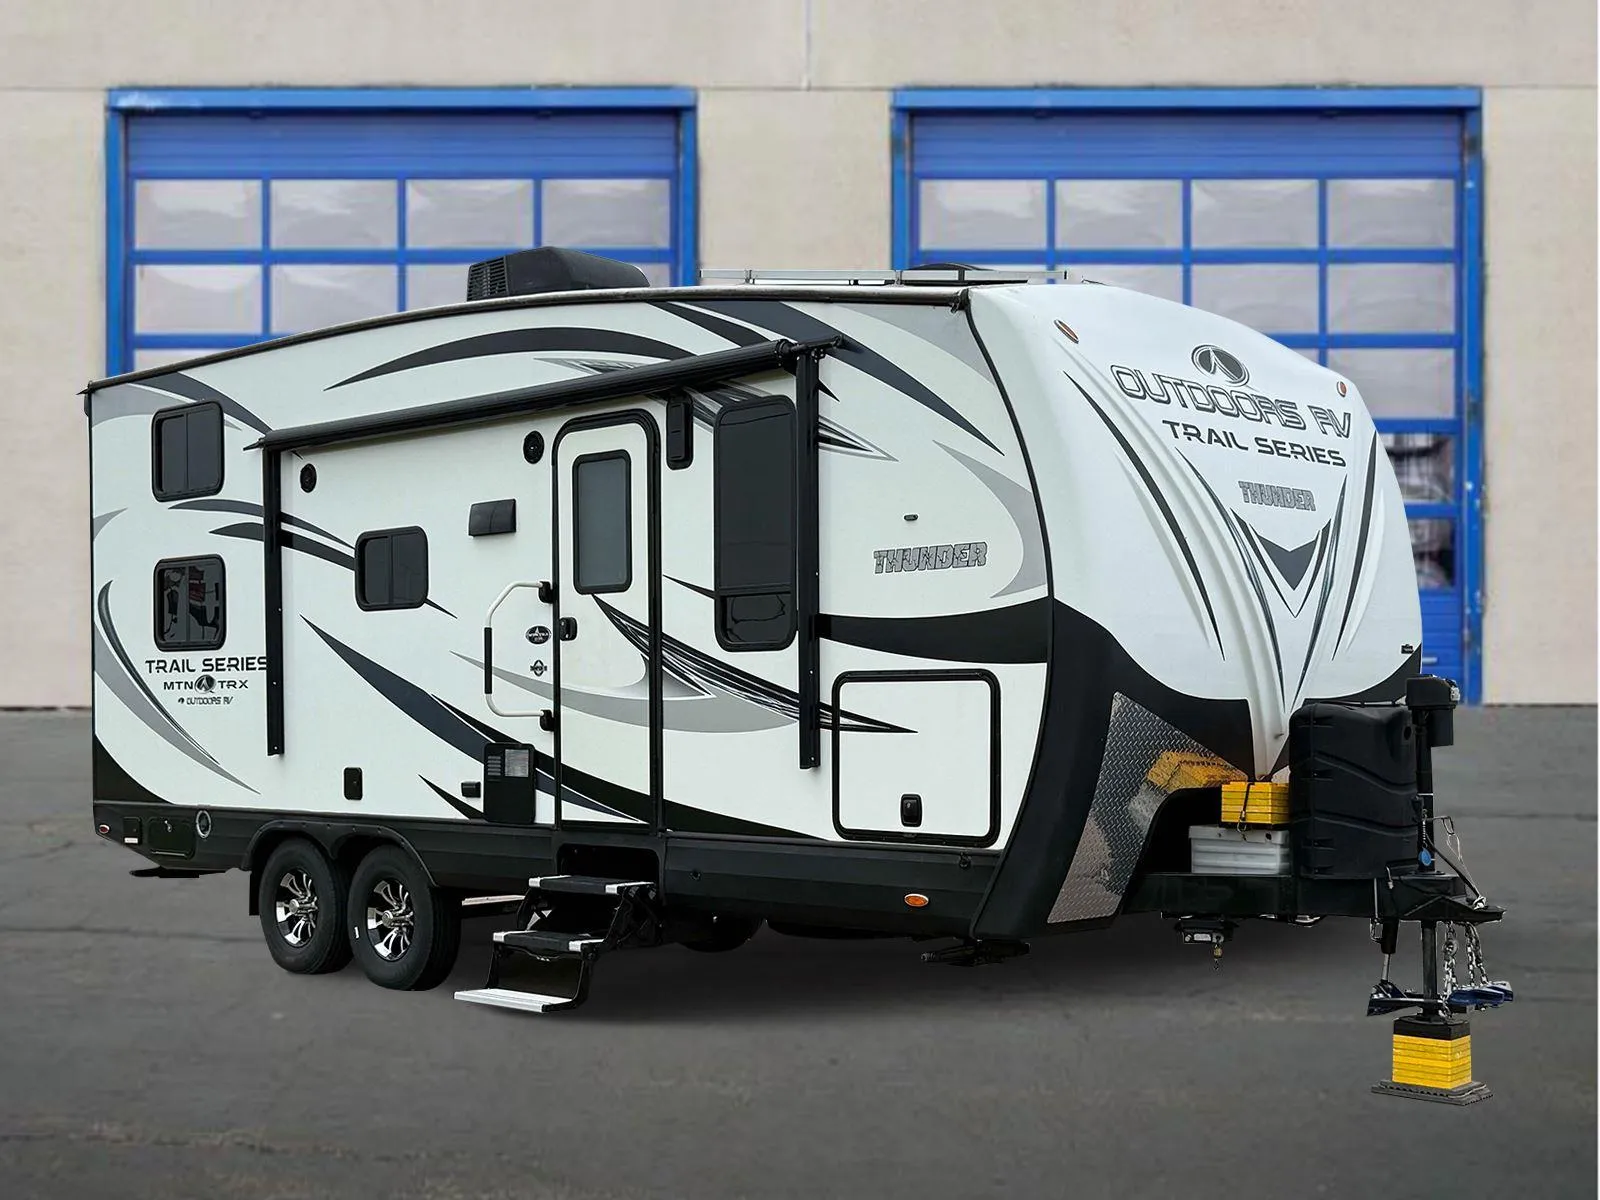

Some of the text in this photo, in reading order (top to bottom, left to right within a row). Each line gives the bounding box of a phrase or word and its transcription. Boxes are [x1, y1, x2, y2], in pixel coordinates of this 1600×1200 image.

[1110, 364, 1352, 439] OUTDOORS RV
[1162, 419, 1347, 467] TRAIL SERIES
[1238, 480, 1317, 511] THUNDER
[873, 541, 988, 574] THUNDER
[145, 656, 267, 674] TRAIL SERIES
[163, 679, 249, 690] MTN TRX
[186, 697, 221, 705] OUTDOORS
